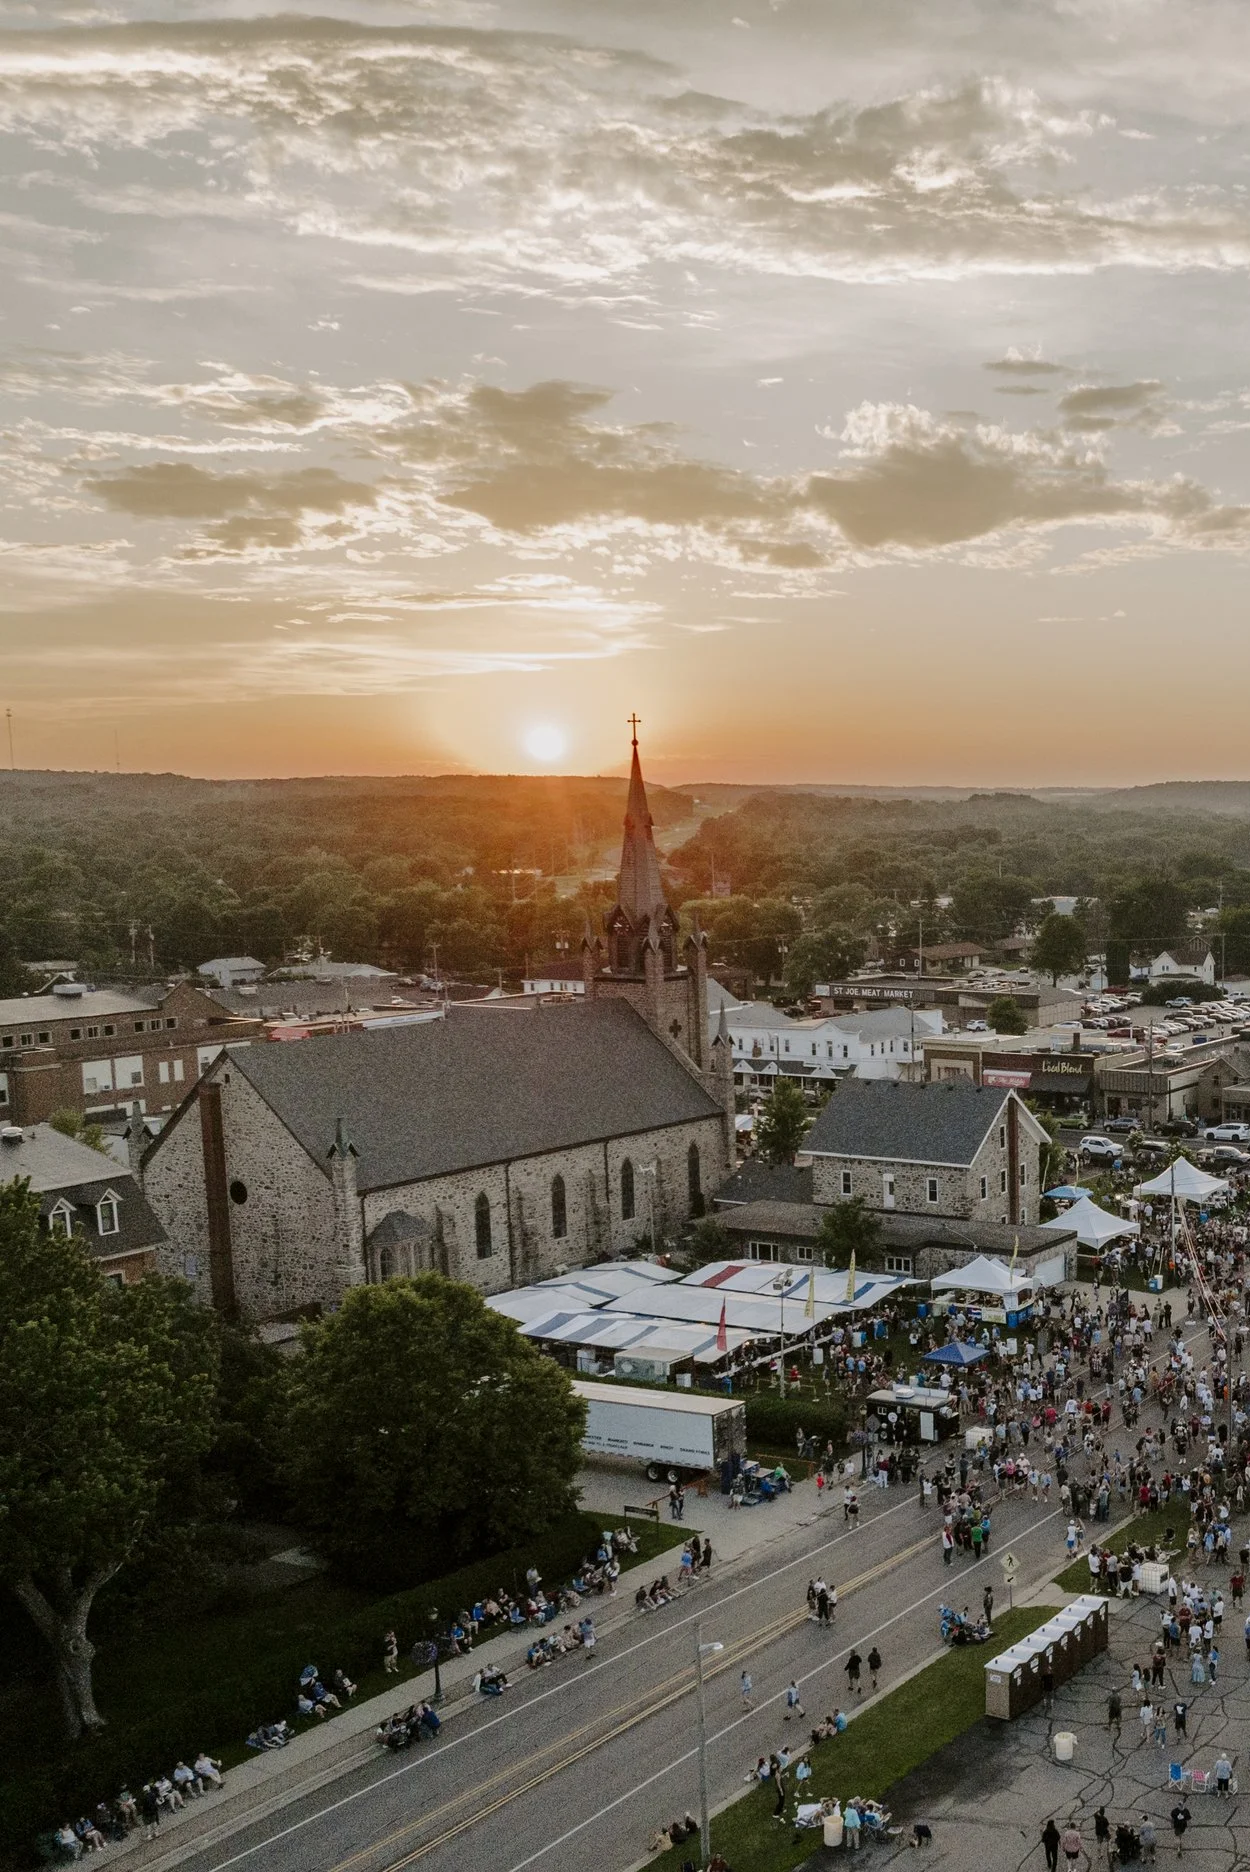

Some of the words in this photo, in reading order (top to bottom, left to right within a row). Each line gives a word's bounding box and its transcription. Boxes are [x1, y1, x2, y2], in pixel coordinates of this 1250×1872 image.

[861, 988, 881, 997] MEAT
[883, 990, 914, 999] MARKET
[1042, 1060, 1060, 1073] Local
[1060, 1061, 1083, 1075] Blend
